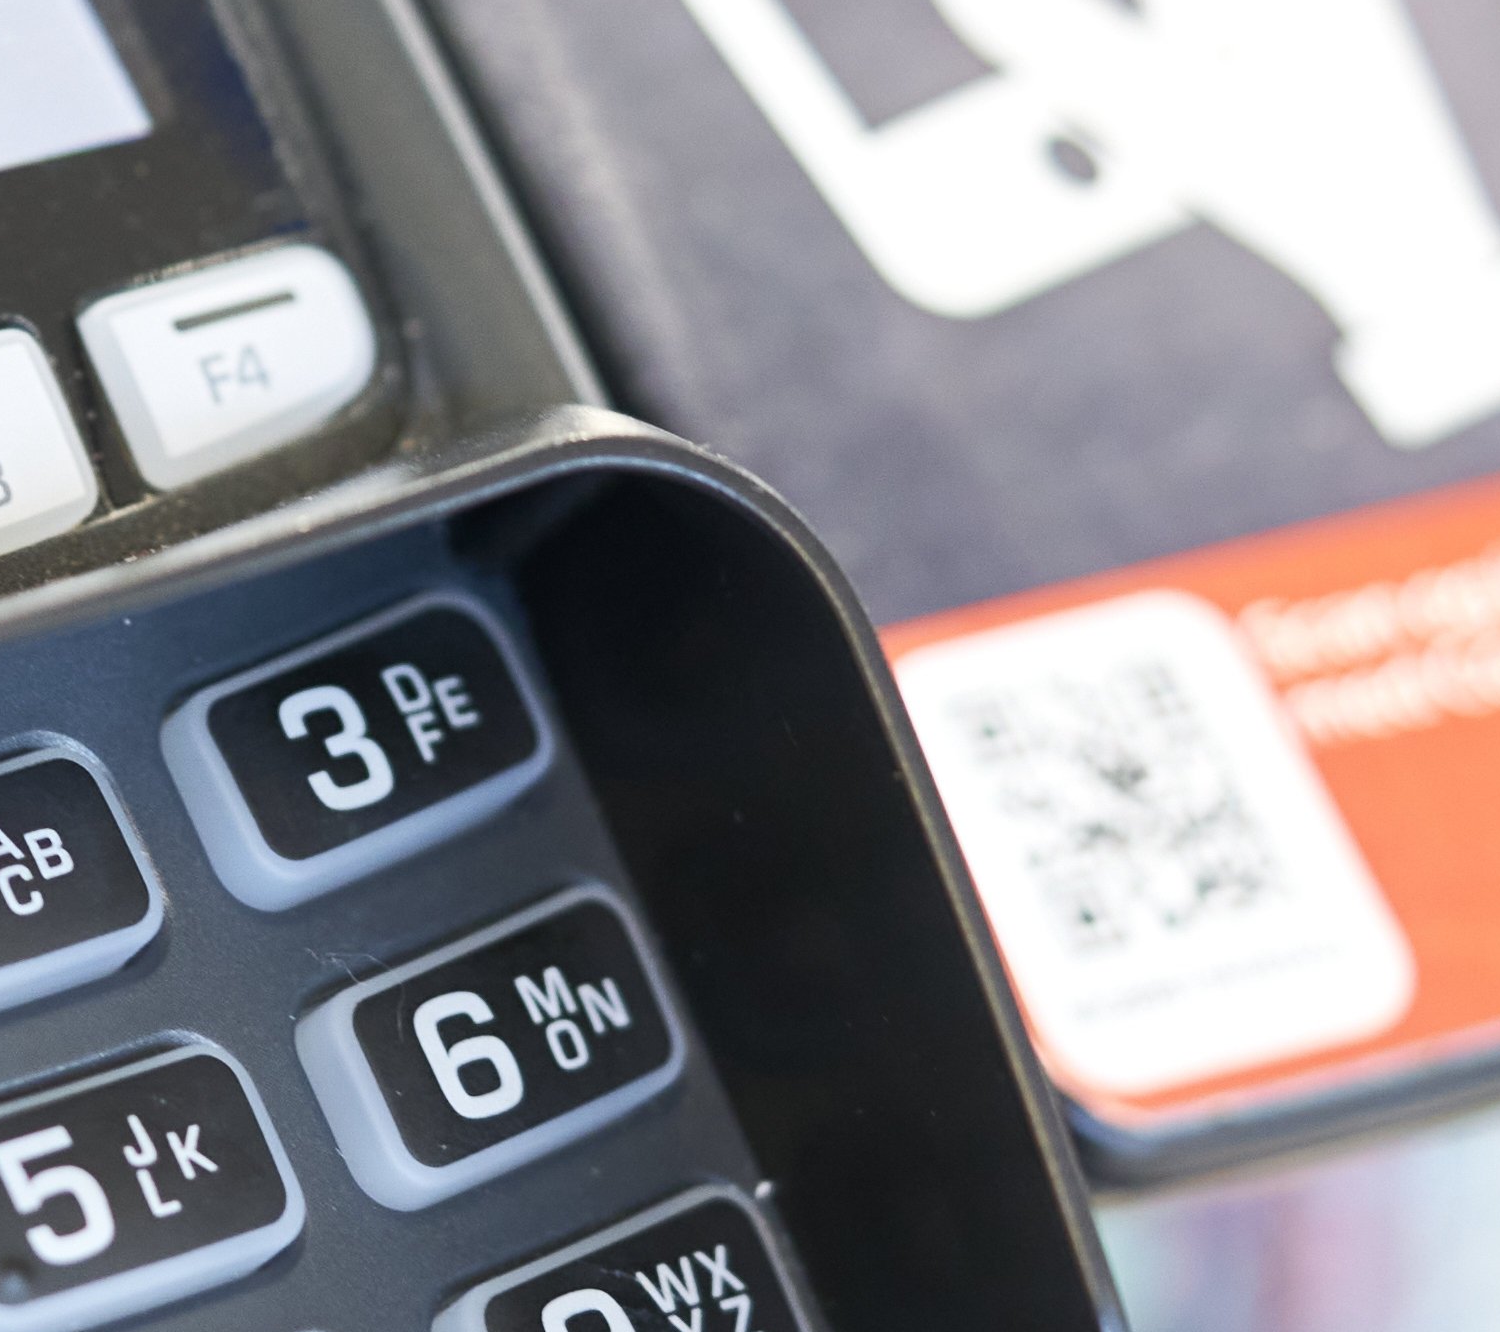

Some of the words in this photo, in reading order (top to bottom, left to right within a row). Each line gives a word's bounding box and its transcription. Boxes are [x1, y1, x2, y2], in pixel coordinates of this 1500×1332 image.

[199, 344, 273, 407] F4
[277, 684, 394, 812] 3
[412, 990, 526, 1120] 6
